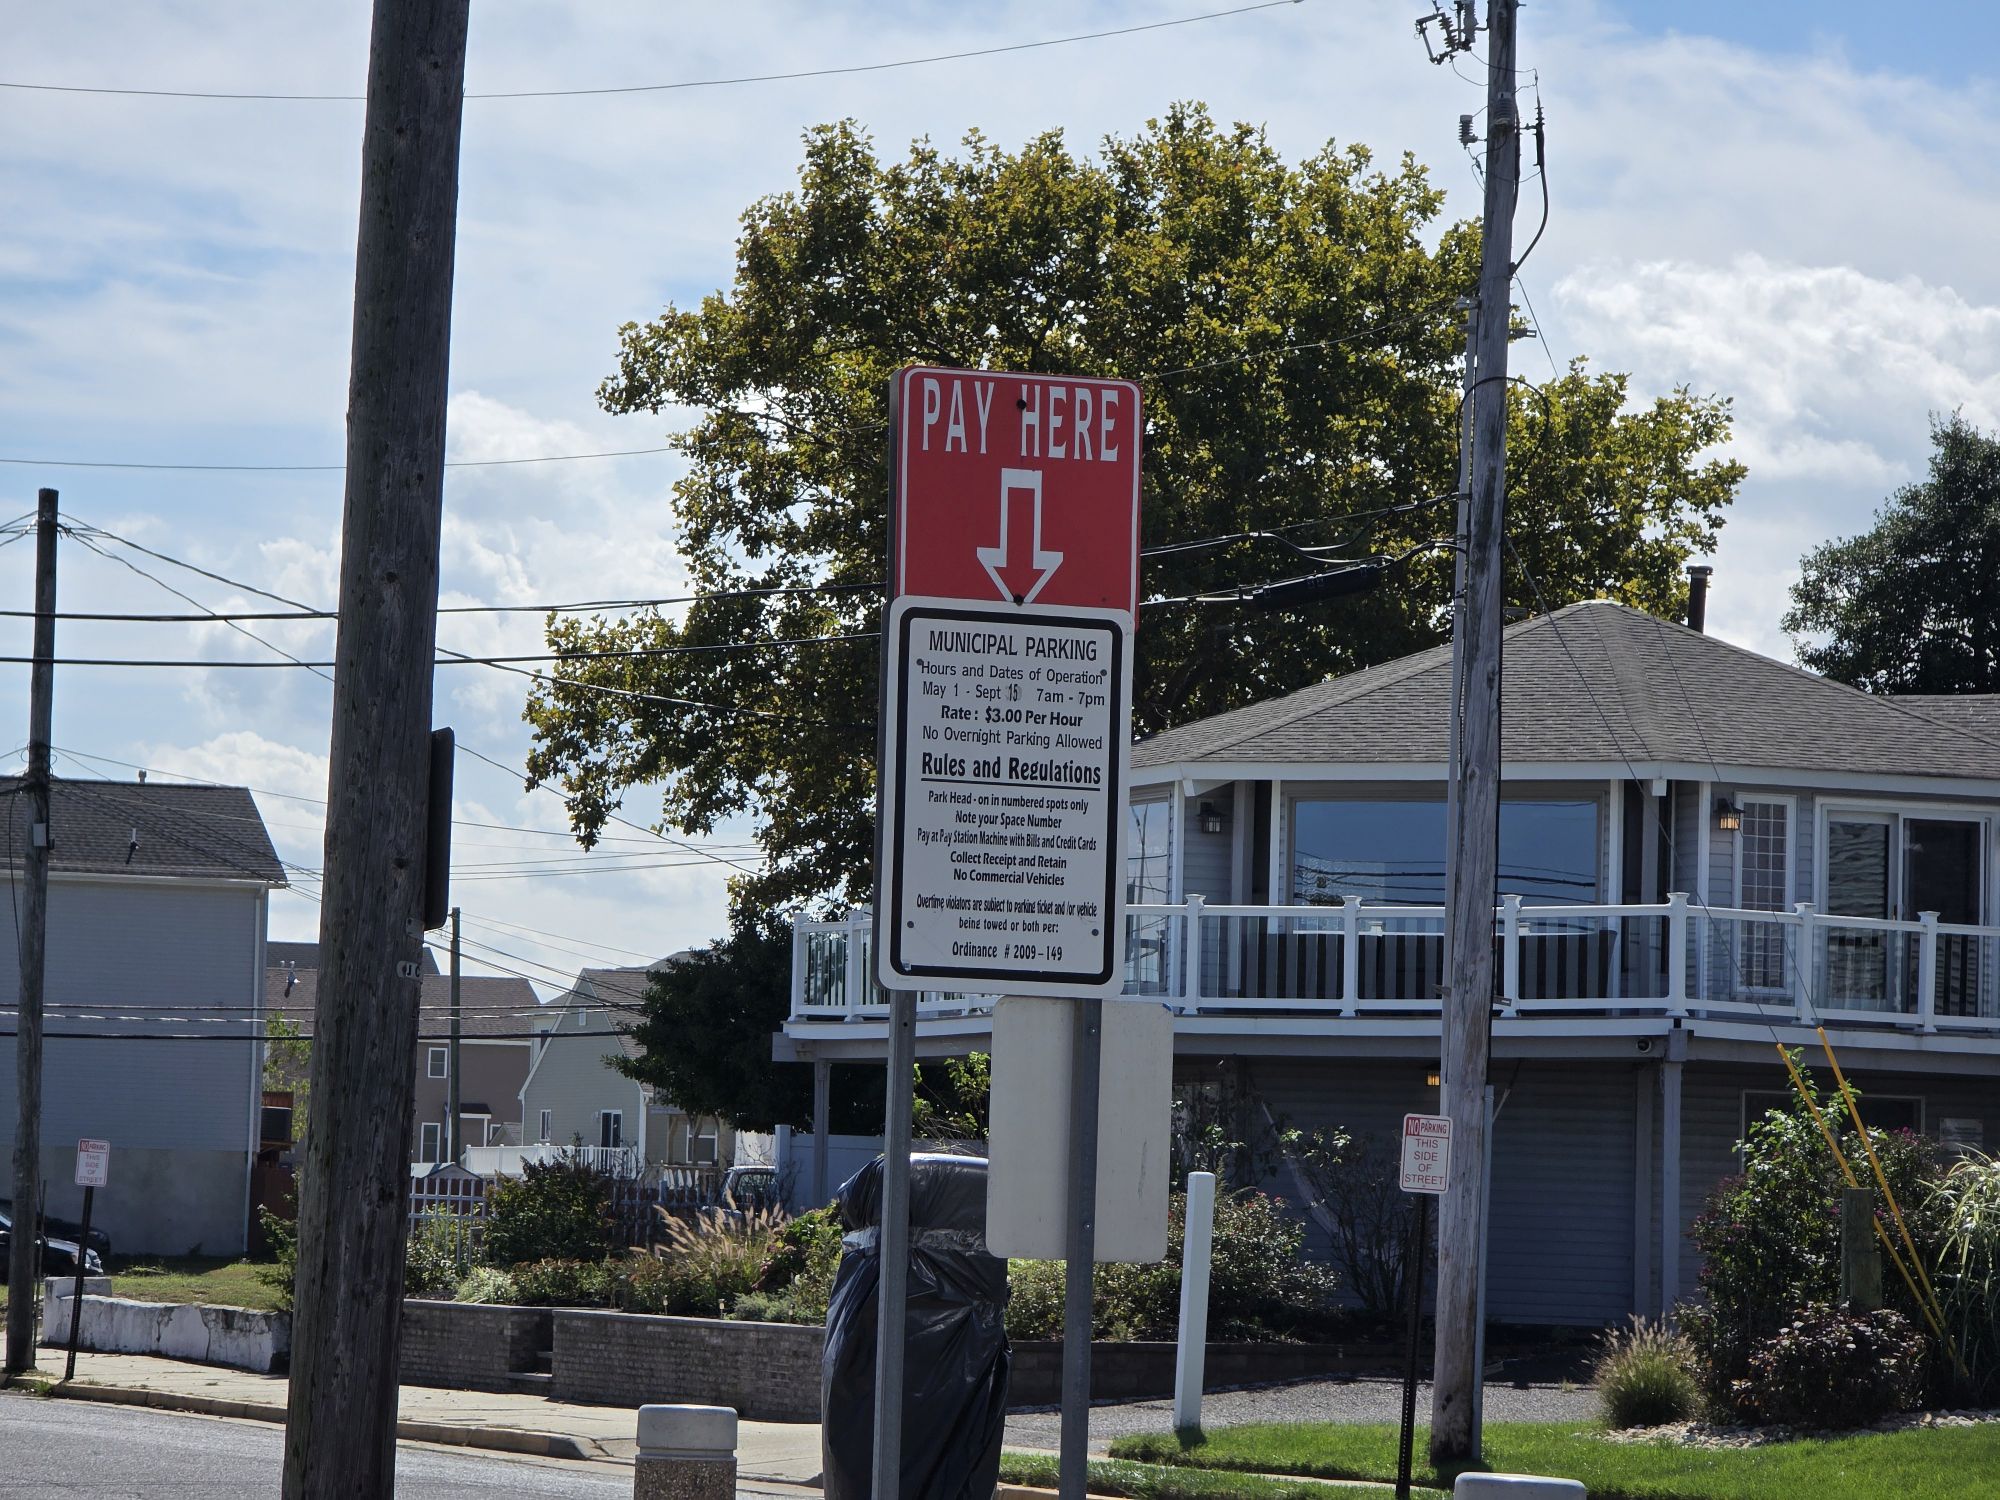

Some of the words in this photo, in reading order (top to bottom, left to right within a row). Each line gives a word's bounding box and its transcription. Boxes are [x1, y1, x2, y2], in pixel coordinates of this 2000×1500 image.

[922, 378, 995, 454] PAY
[1020, 384, 1119, 462] HERE
[929, 630, 1018, 657] MUNICIPAL
[1025, 636, 1097, 661] PARKING
[921, 661, 957, 676] Hours
[962, 665, 984, 678] and
[990, 665, 1023, 680] Dates
[1029, 667, 1042, 681] of
[1046, 668, 1103, 685] Operation
[923, 681, 946, 699] May
[954, 683, 958, 697] 1
[975, 684, 1001, 701] Sept
[1037, 688, 1064, 703] 7am
[1079, 692, 1105, 708] 7pm
[985, 706, 1022, 723] $3.00
[1026, 710, 1047, 725] Per
[1050, 712, 1083, 727] Hour
[922, 726, 938, 740] No
[944, 727, 1001, 746] Overnight
[1006, 730, 1050, 749] Parking
[1056, 734, 1102, 750] Allowed
[922, 752, 966, 776] Rules
[973, 756, 1000, 778] and
[1008, 757, 1101, 784] Regulations
[928, 790, 948, 804] Park
[950, 791, 972, 804] Head
[978, 796, 990, 806] on
[991, 794, 1000, 806] in
[1002, 795, 1044, 808] numbered
[1046, 797, 1068, 812] spots
[1070, 798, 1088, 815] only
[956, 810, 976, 824] Note
[978, 814, 998, 828] your
[1000, 812, 1026, 829] Space
[1028, 814, 1062, 828] Number
[918, 828, 930, 846] Pay
[931, 830, 938, 842] at
[940, 828, 952, 847] Pay
[954, 830, 978, 844] Station
[980, 830, 1008, 846] Machine
[1010, 832, 1025, 847] with
[1026, 833, 1040, 848] Bills
[1042, 834, 1054, 848] and
[1056, 836, 1076, 850] Credit
[1078, 836, 1097, 851] Cards
[950, 850, 981, 864] Collect
[983, 852, 1017, 869] Receipt
[1018, 855, 1036, 868] and
[1038, 856, 1067, 869] Retain
[954, 868, 968, 881] No
[970, 870, 1024, 884] Commercial
[1026, 872, 1064, 886] Vehicles
[916, 894, 945, 910] Overtime
[946, 894, 971, 911] violators
[972, 899, 982, 912] are
[984, 898, 1005, 912] subject
[1006, 900, 1012, 912] to
[1014, 900, 1036, 914] parking
[1036, 901, 1053, 914] ticket
[1054, 902, 1065, 916] and
[1077, 902, 1098, 918] vehicle
[959, 916, 981, 930] being
[984, 918, 1008, 931] towed
[1010, 920, 1020, 932] or
[1022, 920, 1040, 932] both
[1042, 923, 1059, 934] per:
[952, 940, 998, 958] Ordinance
[1004, 944, 1010, 958] #
[1408, 1118, 1420, 1136] NO
[1420, 1122, 1447, 1134] PARKING
[1416, 1138, 1438, 1149] THIS
[1414, 1151, 1438, 1162] SIDE
[1418, 1164, 1432, 1172] OF
[1404, 1174, 1445, 1186] STREET
